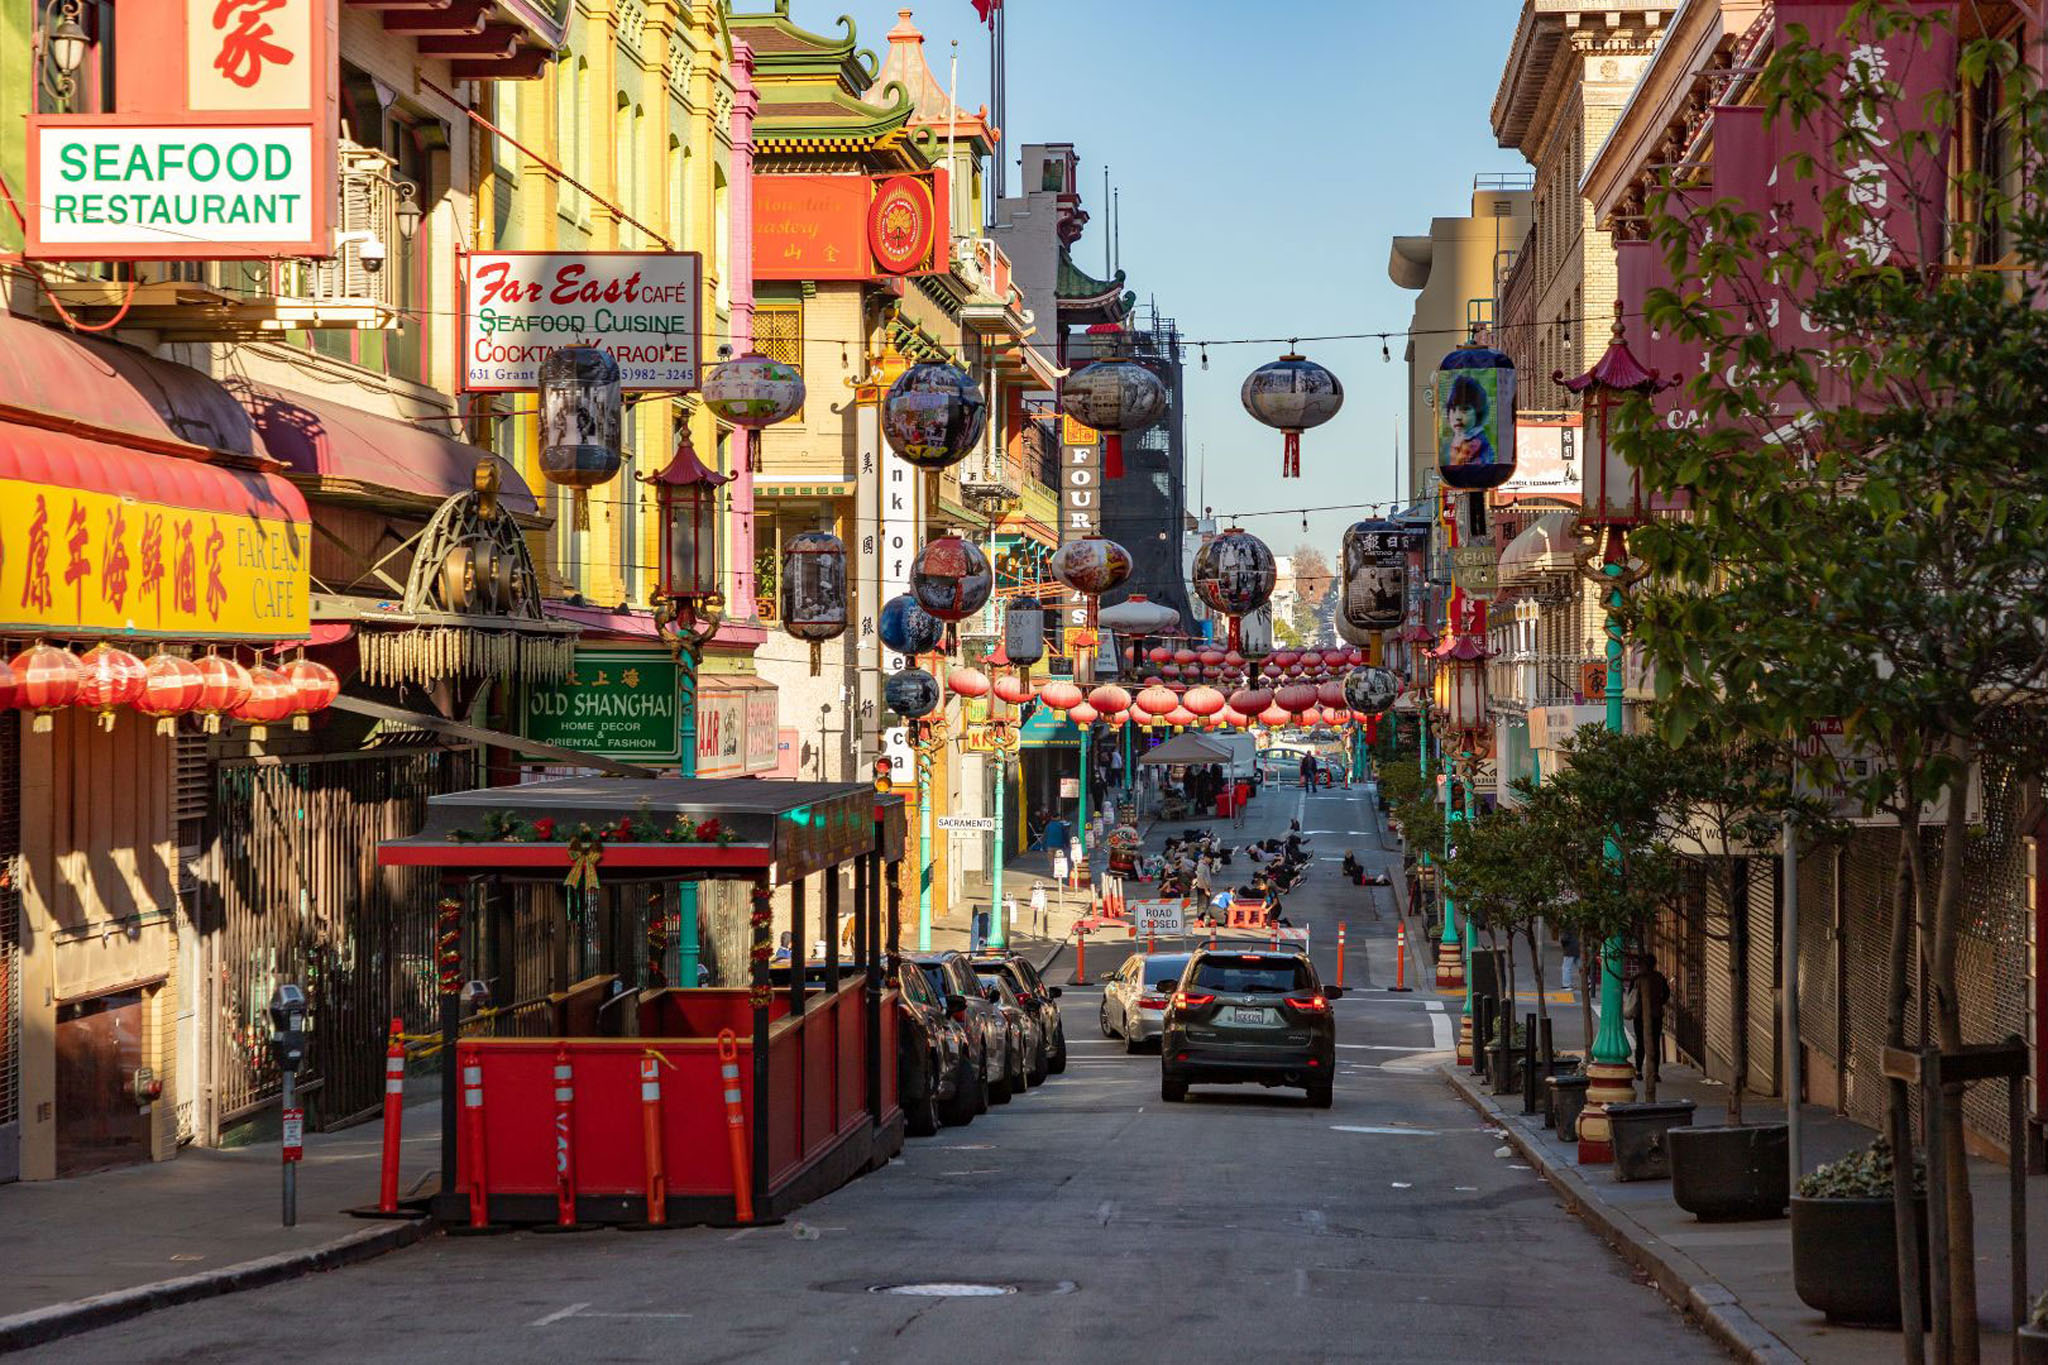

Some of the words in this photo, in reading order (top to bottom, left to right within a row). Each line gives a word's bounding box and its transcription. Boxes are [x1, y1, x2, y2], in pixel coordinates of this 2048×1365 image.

[60, 142, 292, 183] SEAFOOD
[55, 193, 301, 225] RESTAURANT
[476, 262, 543, 305] Far
[550, 264, 640, 304] East
[641, 281, 686, 303] CAFÉ
[479, 308, 585, 333] SEAFOOD
[595, 308, 684, 332] CUISINE
[475, 338, 562, 363] COCKTA
[470, 369, 489, 380] 631
[495, 369, 534, 380] Grant
[1070, 448, 1092, 528] FOUR
[237, 528, 267, 570] FAR
[892, 536, 904, 577] of
[253, 579, 294, 618] CAFE
[531, 692, 568, 716] OLD
[574, 693, 672, 717] SHANGHAI
[561, 722, 594, 731] HOME
[602, 722, 641, 731] DECOR
[597, 731, 604, 739] &
[546, 738, 601, 747] ORIENTAL
[608, 739, 656, 748] FASHION
[938, 818, 992, 828] SACRAMENTO
[1140, 919, 1178, 928] COSED
[1146, 908, 1172, 917] ROAD
